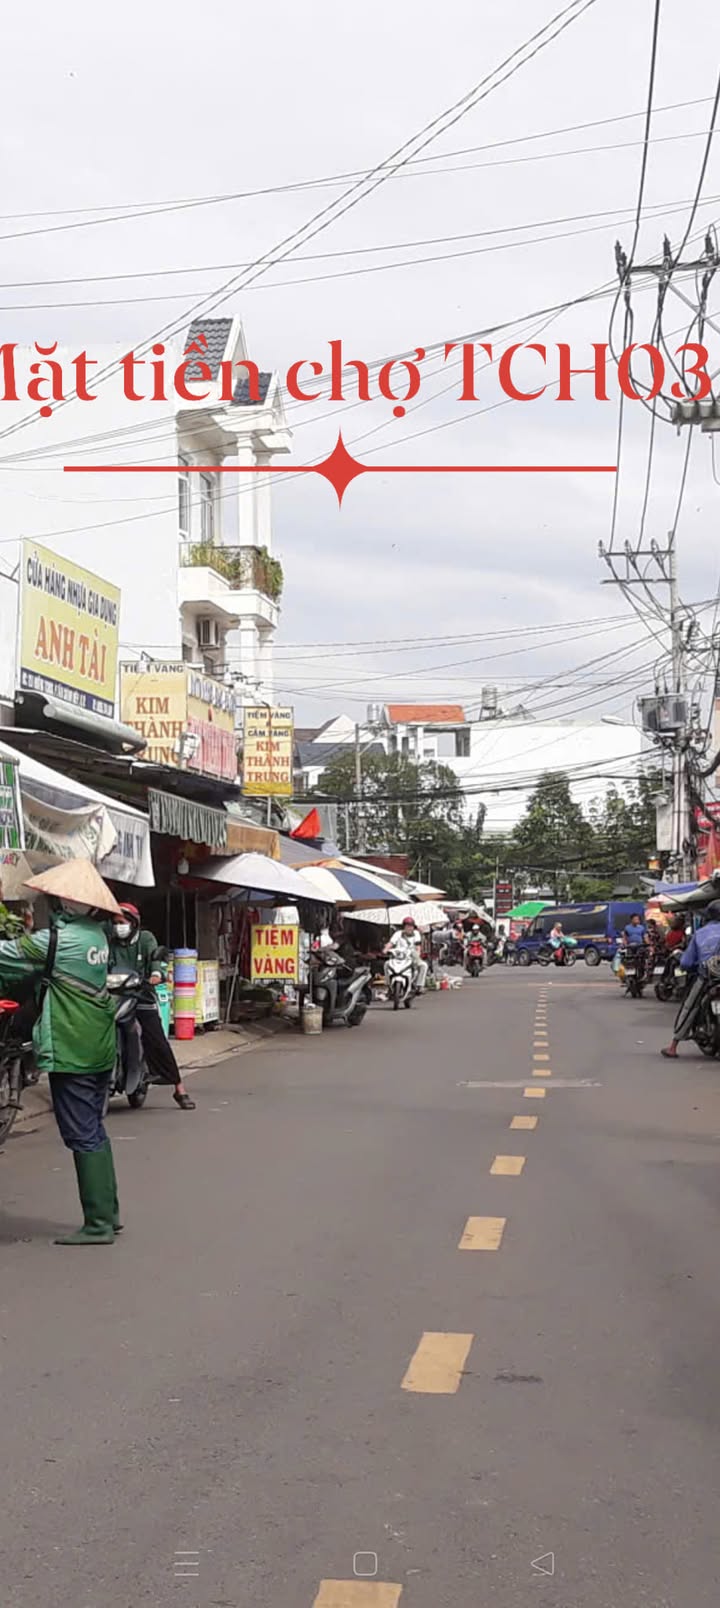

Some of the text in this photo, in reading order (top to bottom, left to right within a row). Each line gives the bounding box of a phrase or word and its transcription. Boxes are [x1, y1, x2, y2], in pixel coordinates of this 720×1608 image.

[44, 563, 66, 600] HÀNG
[88, 589, 99, 617] GIA
[34, 615, 107, 683] ANH TÀI
[136, 697, 170, 715] KIM
[256, 741, 280, 752] KIM
[247, 772, 289, 783] TRUNG
[255, 925, 294, 949] TIỆM
[254, 953, 295, 974] VÀNG
